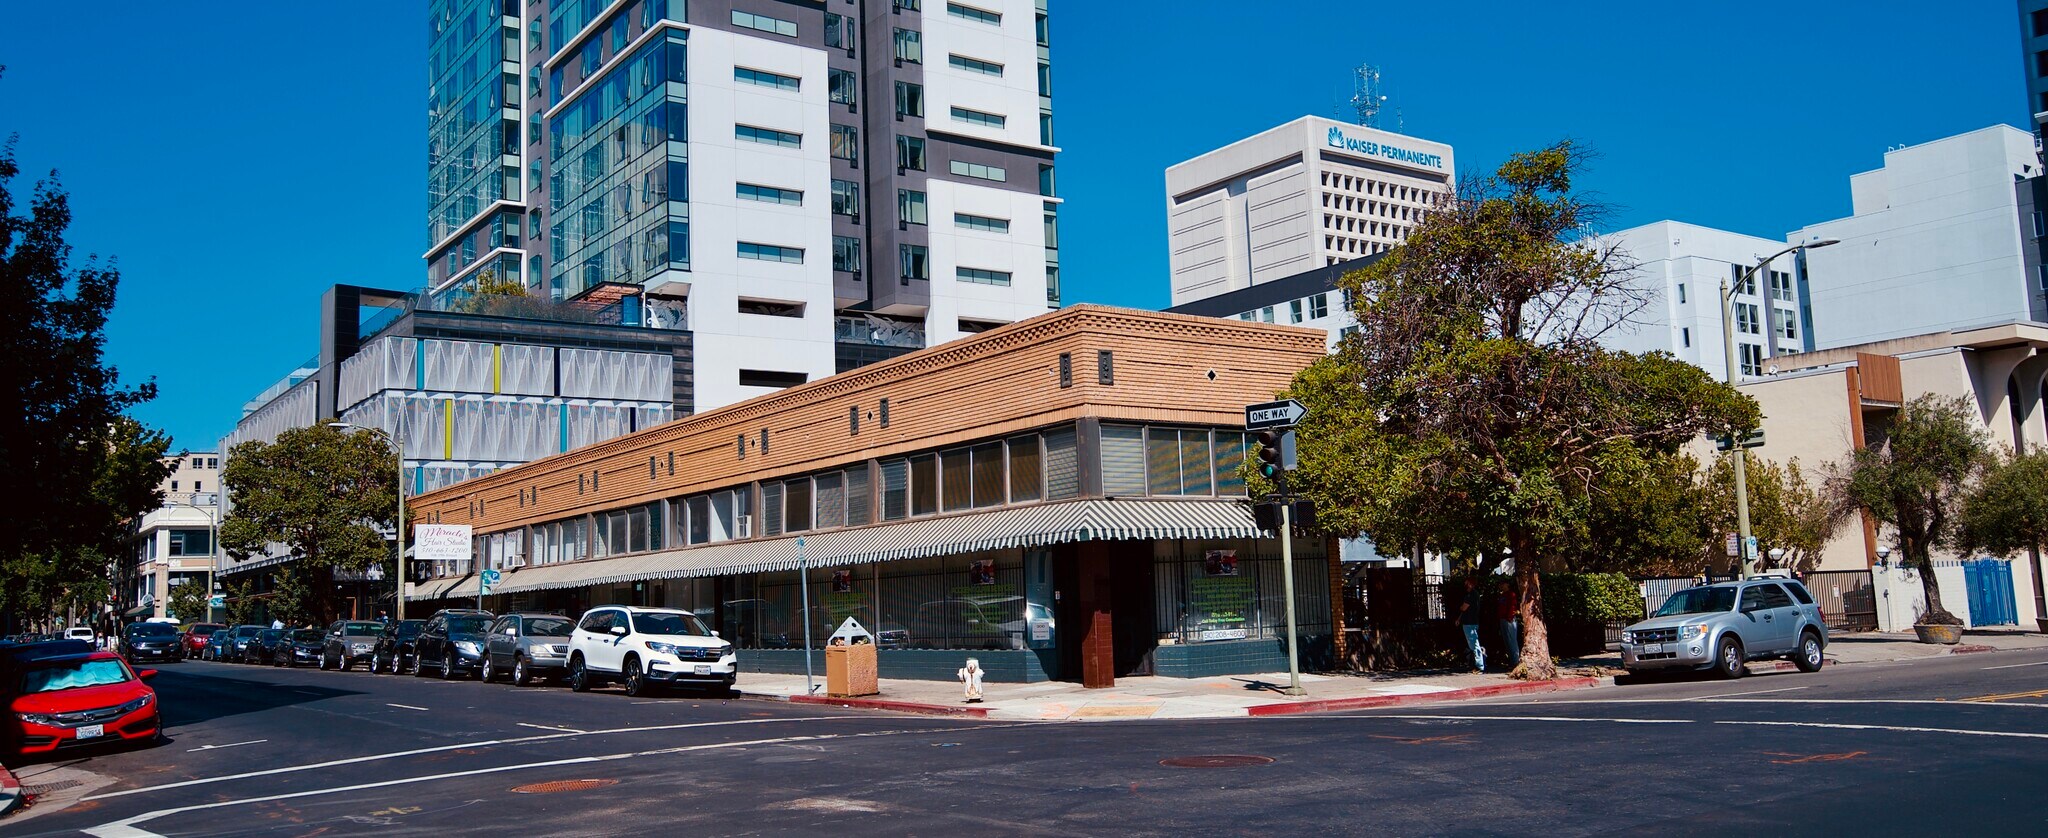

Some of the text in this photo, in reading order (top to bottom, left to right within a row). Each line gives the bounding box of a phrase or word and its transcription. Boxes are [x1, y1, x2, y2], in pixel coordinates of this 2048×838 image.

[1346, 138, 1442, 168] KAISER PERMANENTE
[1252, 408, 1289, 421] ONE WAY
